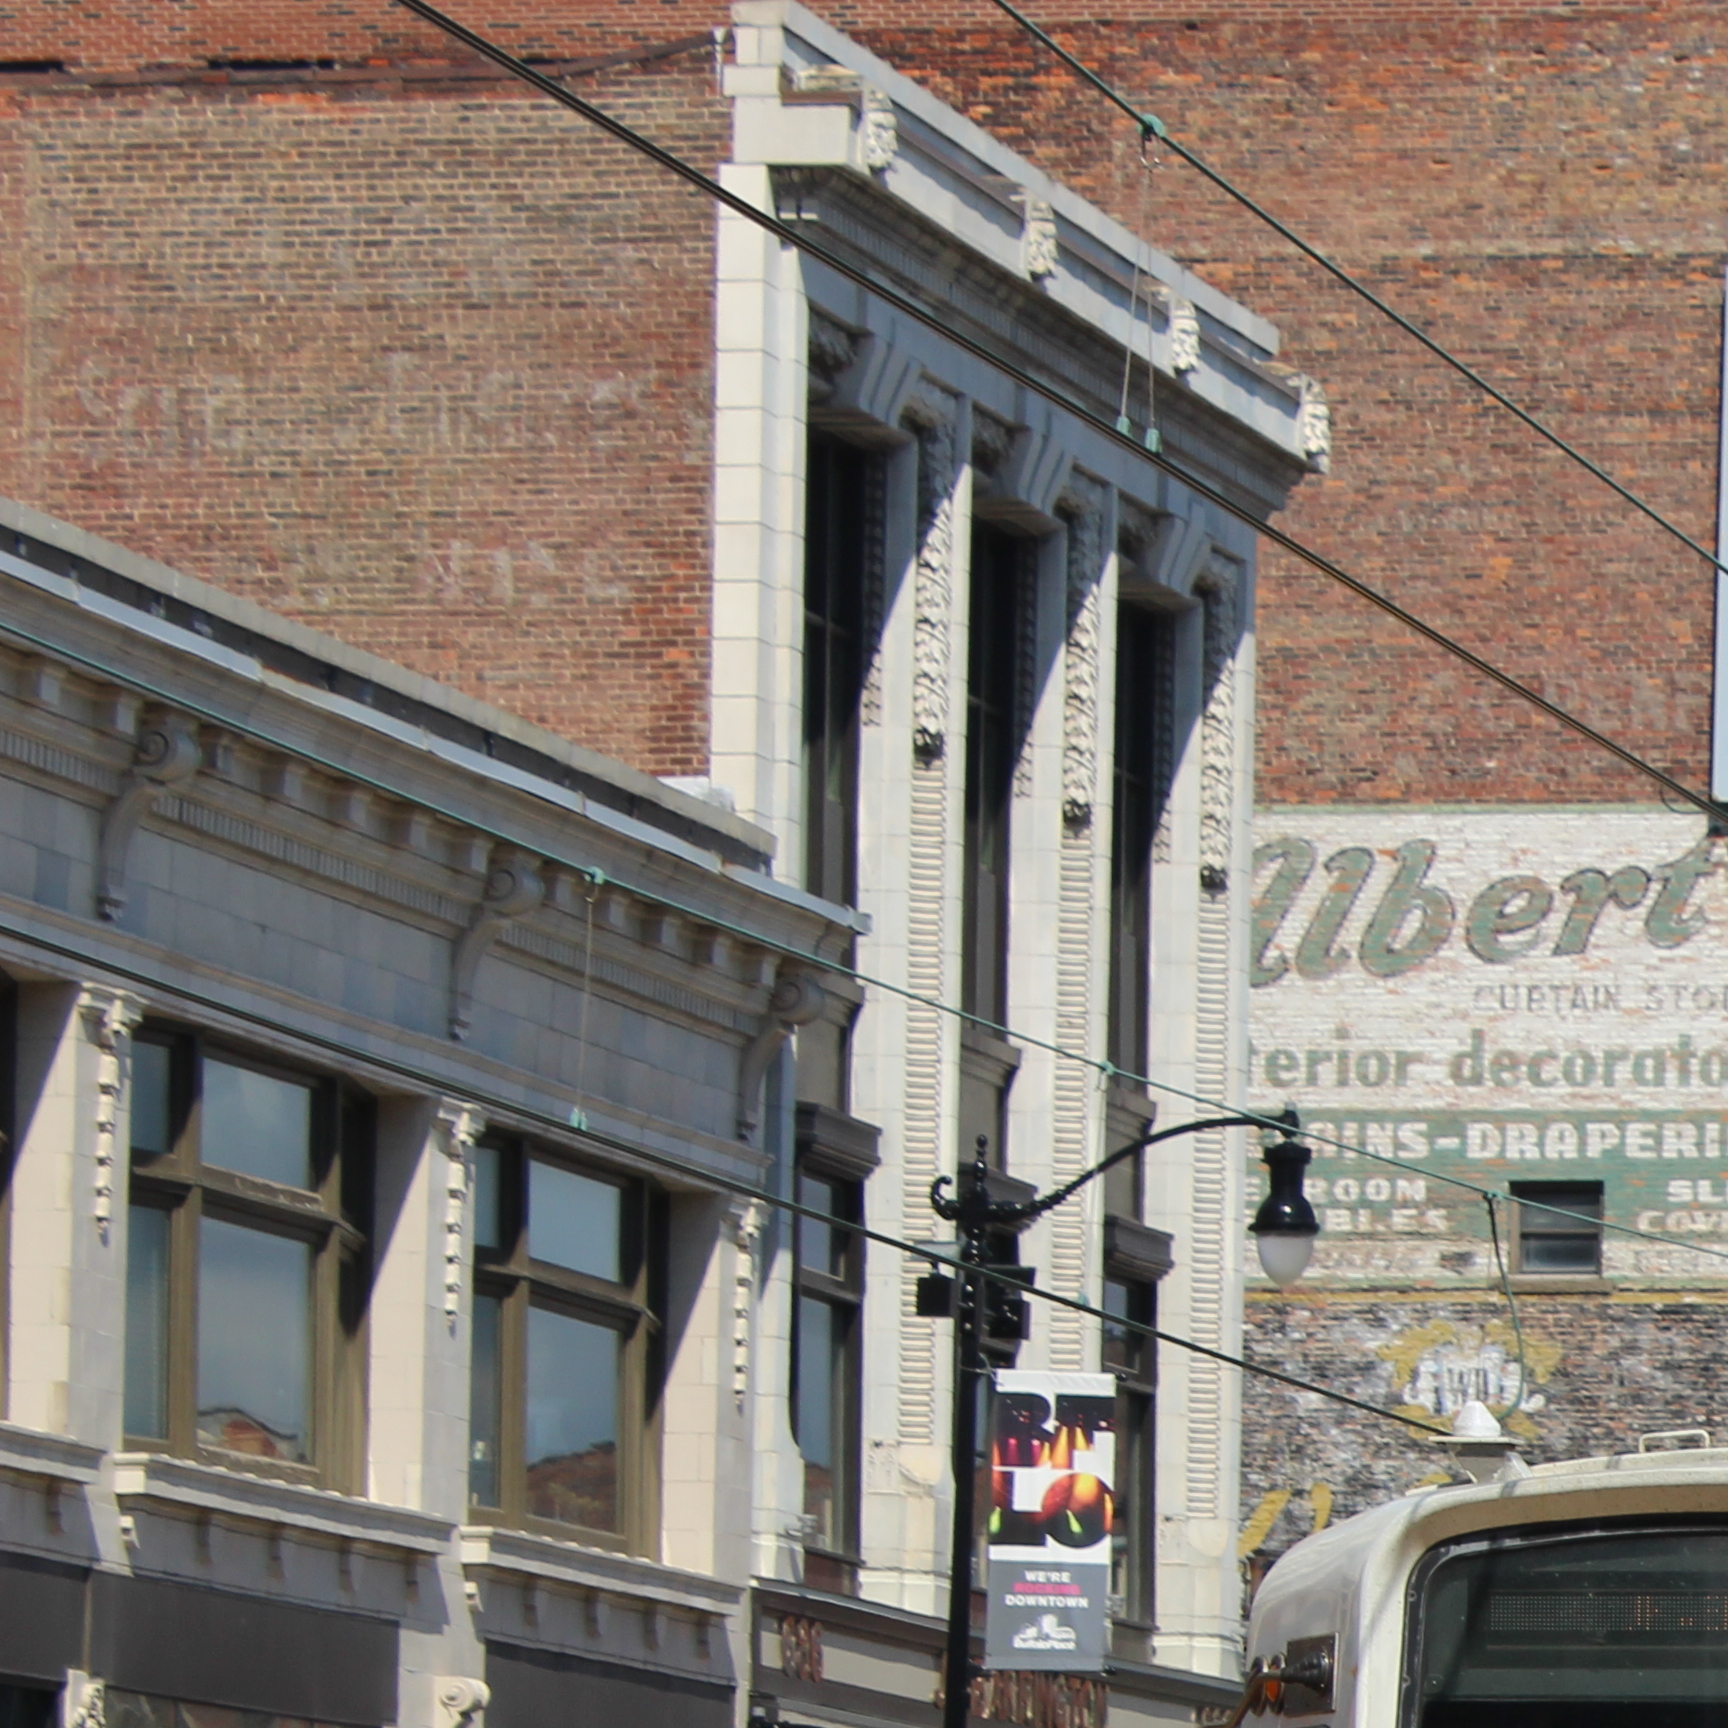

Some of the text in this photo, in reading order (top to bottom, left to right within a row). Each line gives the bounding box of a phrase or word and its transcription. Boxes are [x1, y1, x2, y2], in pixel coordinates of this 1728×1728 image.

[1473, 983, 1621, 1013] CURTAIN
[1024, 1570, 1071, 1583] WE'RE
[1004, 1594, 1089, 1608] DOWNTOWN
